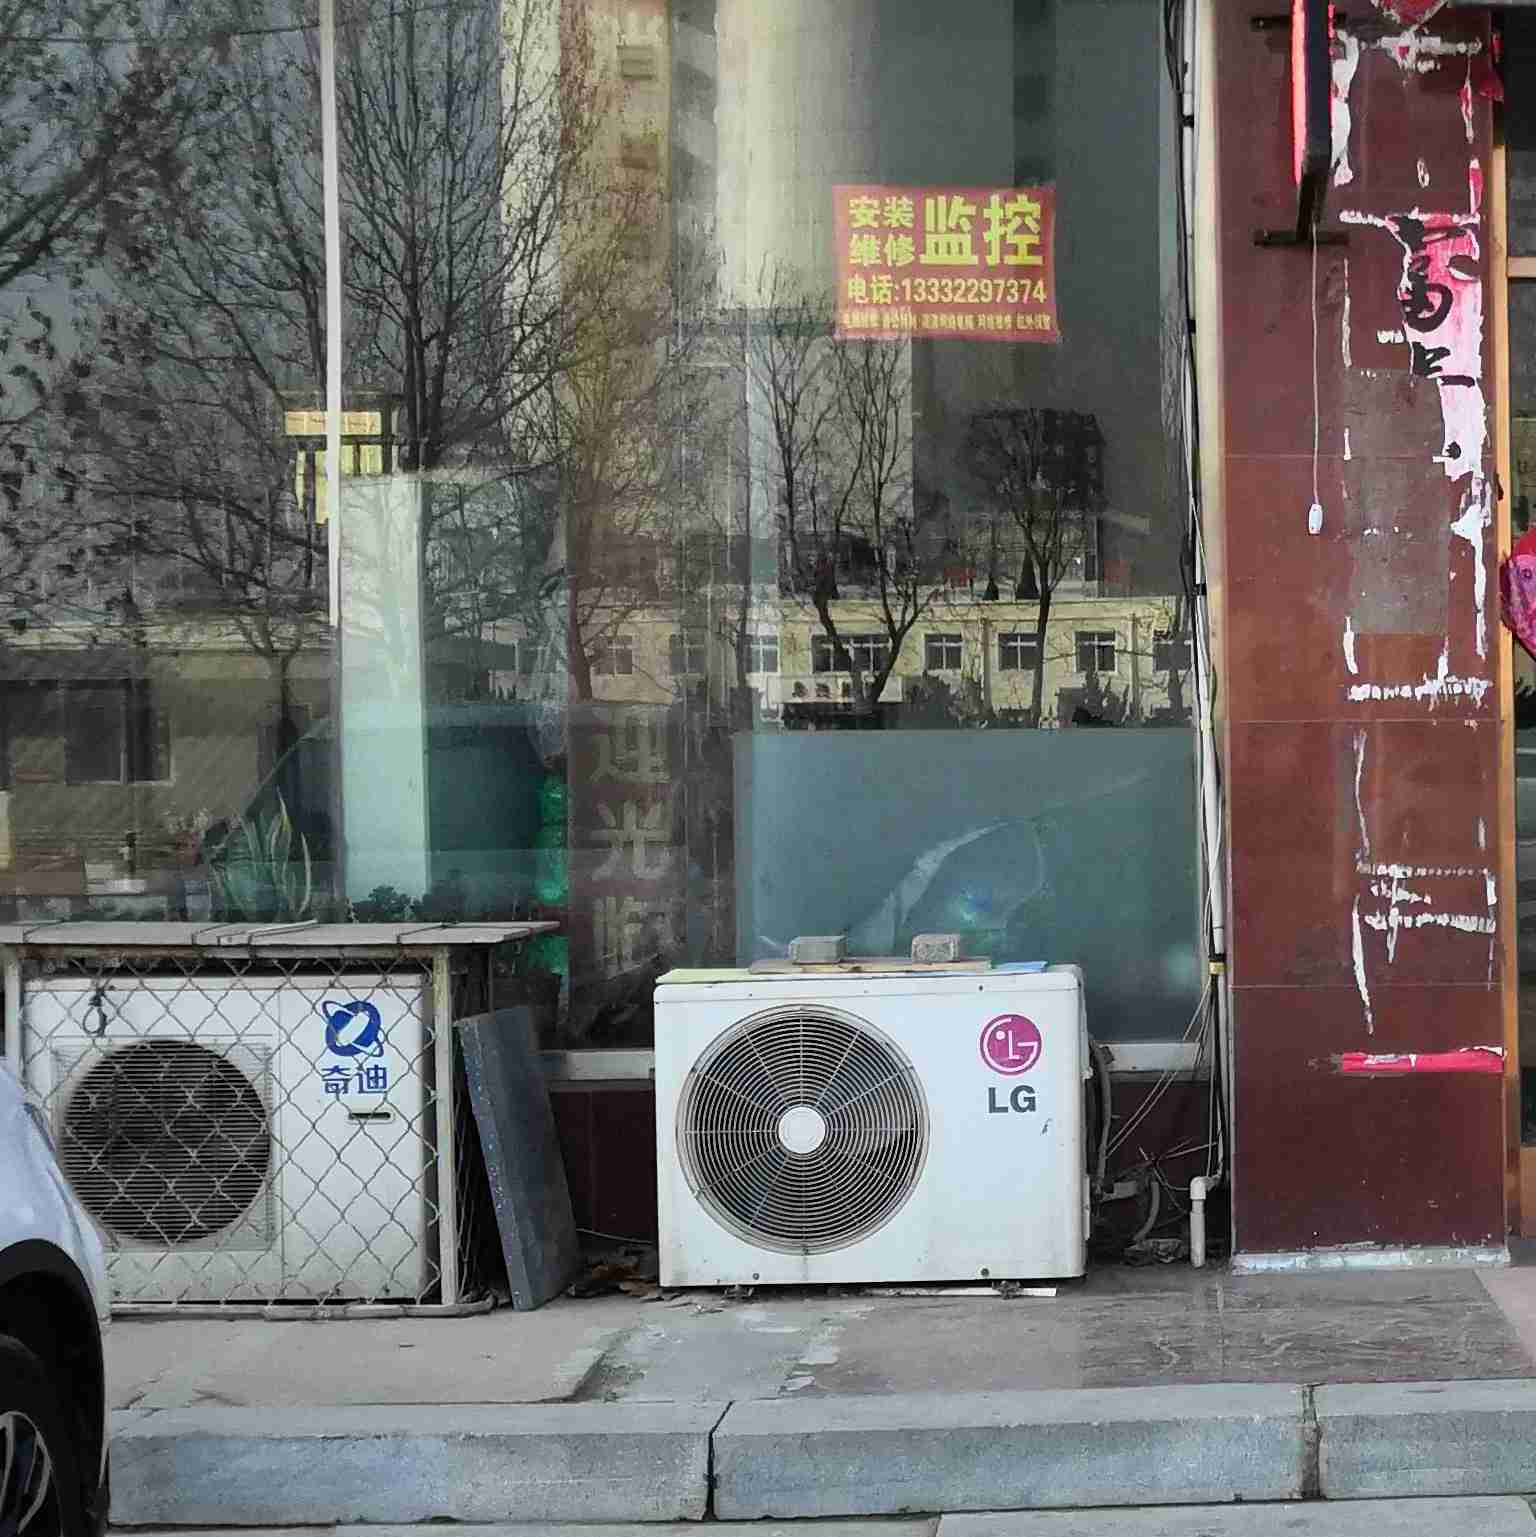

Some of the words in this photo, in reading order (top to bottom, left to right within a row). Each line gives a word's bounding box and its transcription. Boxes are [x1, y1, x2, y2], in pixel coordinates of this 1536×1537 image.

[848, 195, 914, 228] 安装
[919, 193, 1043, 267] 监控
[848, 233, 914, 267] 维修
[321, 1064, 388, 1095] 奇迪
[988, 1085, 1036, 1114] LG
